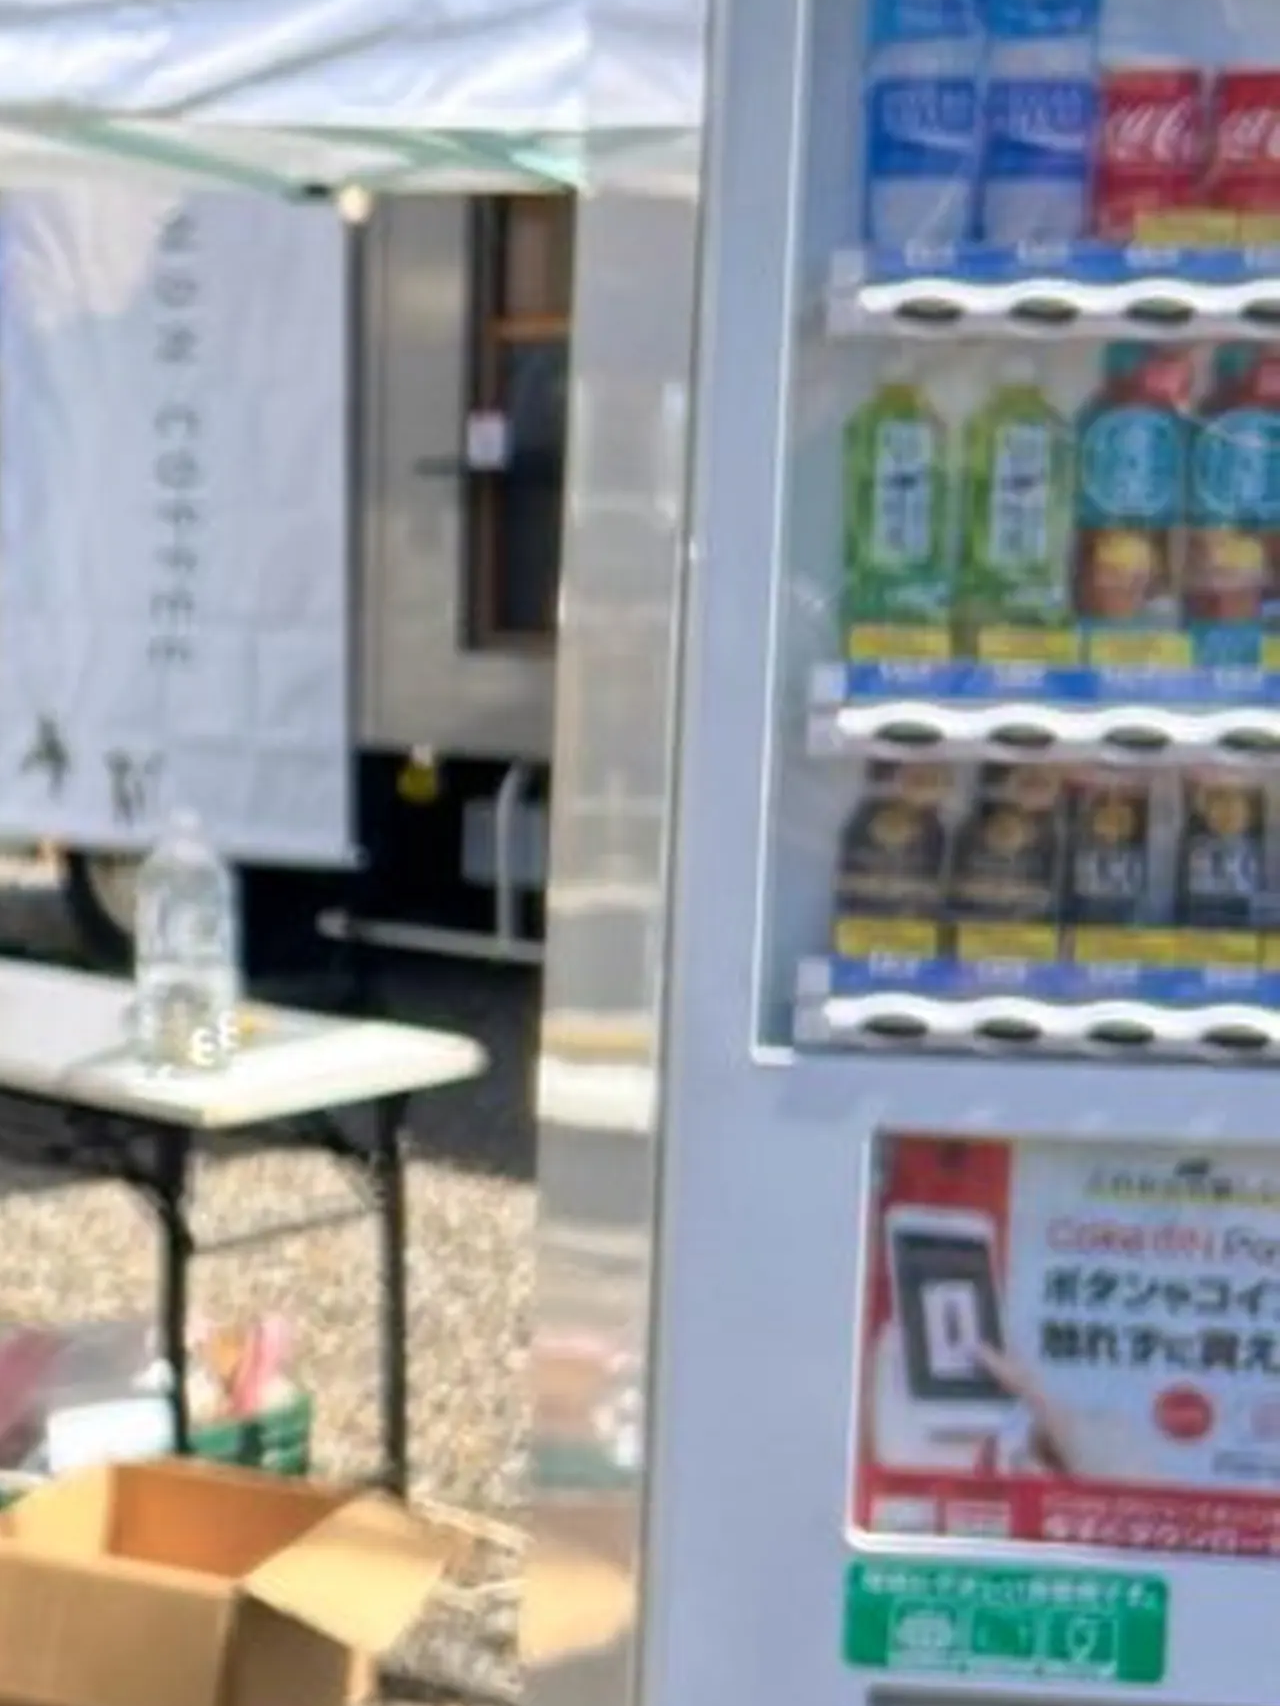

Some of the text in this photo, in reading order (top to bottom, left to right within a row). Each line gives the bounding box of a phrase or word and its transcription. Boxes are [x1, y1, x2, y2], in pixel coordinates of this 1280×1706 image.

[1043, 1266, 1279, 1318] ボタンやコイ
